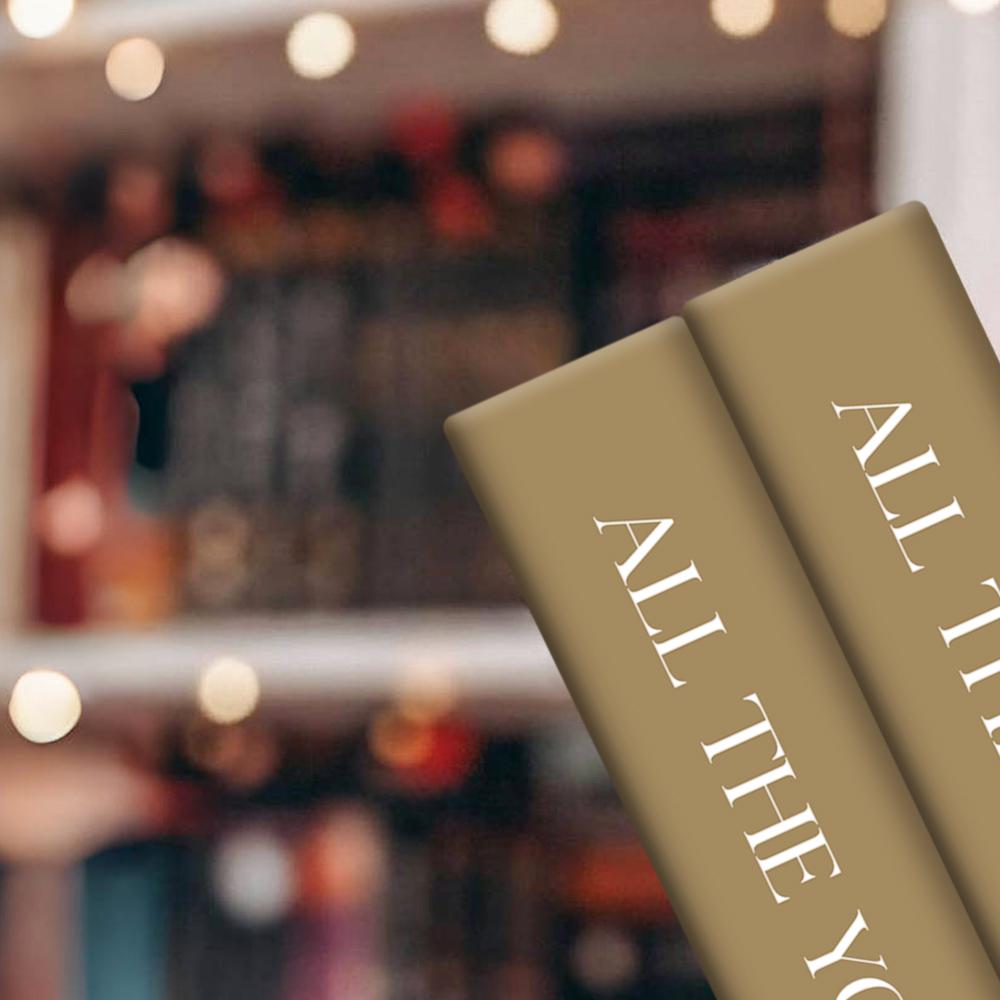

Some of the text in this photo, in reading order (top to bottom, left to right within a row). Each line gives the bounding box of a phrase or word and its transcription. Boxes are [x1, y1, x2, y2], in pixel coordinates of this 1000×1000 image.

[830, 400, 966, 574] ALL
[592, 516, 728, 690] ALL
[699, 691, 843, 905] THE
